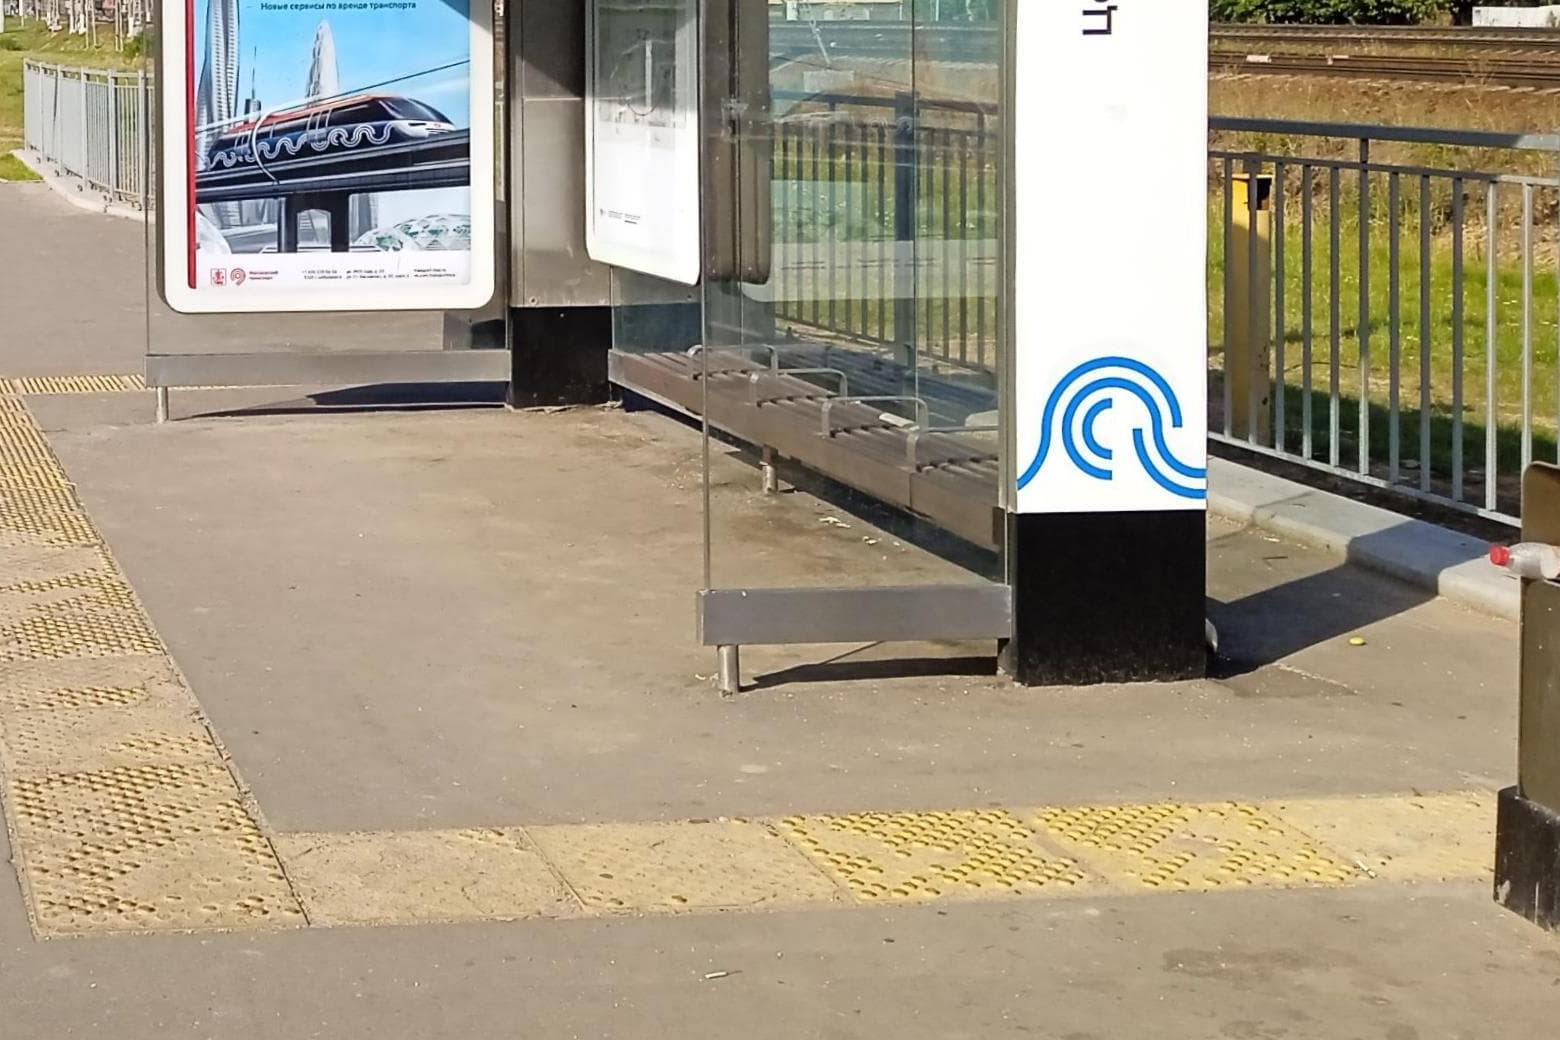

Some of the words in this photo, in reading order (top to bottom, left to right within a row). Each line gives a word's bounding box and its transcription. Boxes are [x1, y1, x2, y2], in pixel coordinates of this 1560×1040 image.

[260, 2, 288, 10] Новые
[289, 3, 325, 11] сервисы
[338, 2, 368, 10] аренде
[369, 2, 417, 10] транспорта
